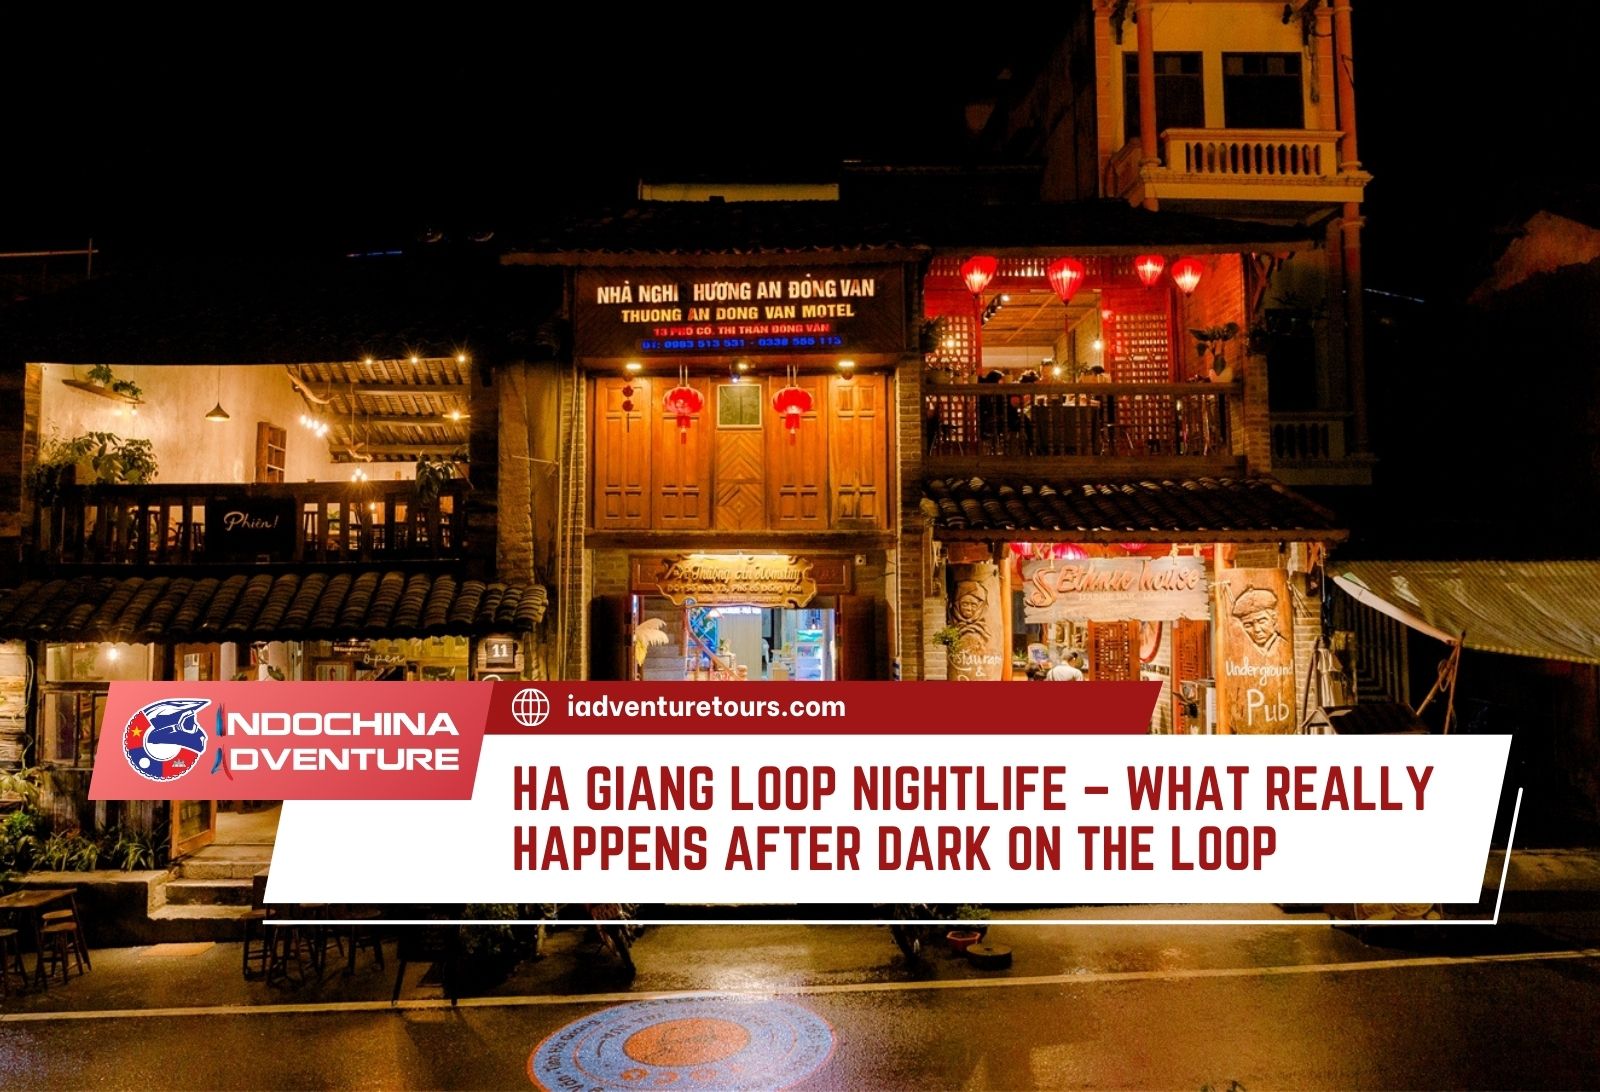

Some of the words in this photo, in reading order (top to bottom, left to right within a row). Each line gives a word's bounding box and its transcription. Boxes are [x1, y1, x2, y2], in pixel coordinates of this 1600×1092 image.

[757, 280, 781, 299] AN
[621, 308, 682, 323] THUONG
[687, 306, 710, 321] AN
[716, 306, 758, 320] DONG
[764, 305, 796, 320] VAN
[802, 303, 855, 318] MOTEL
[1057, 564, 1134, 594] Ethnic
[1138, 560, 1200, 592] house
[492, 644, 509, 657] 11
[1225, 656, 1294, 687] Underground
[1247, 688, 1290, 726] Pub
